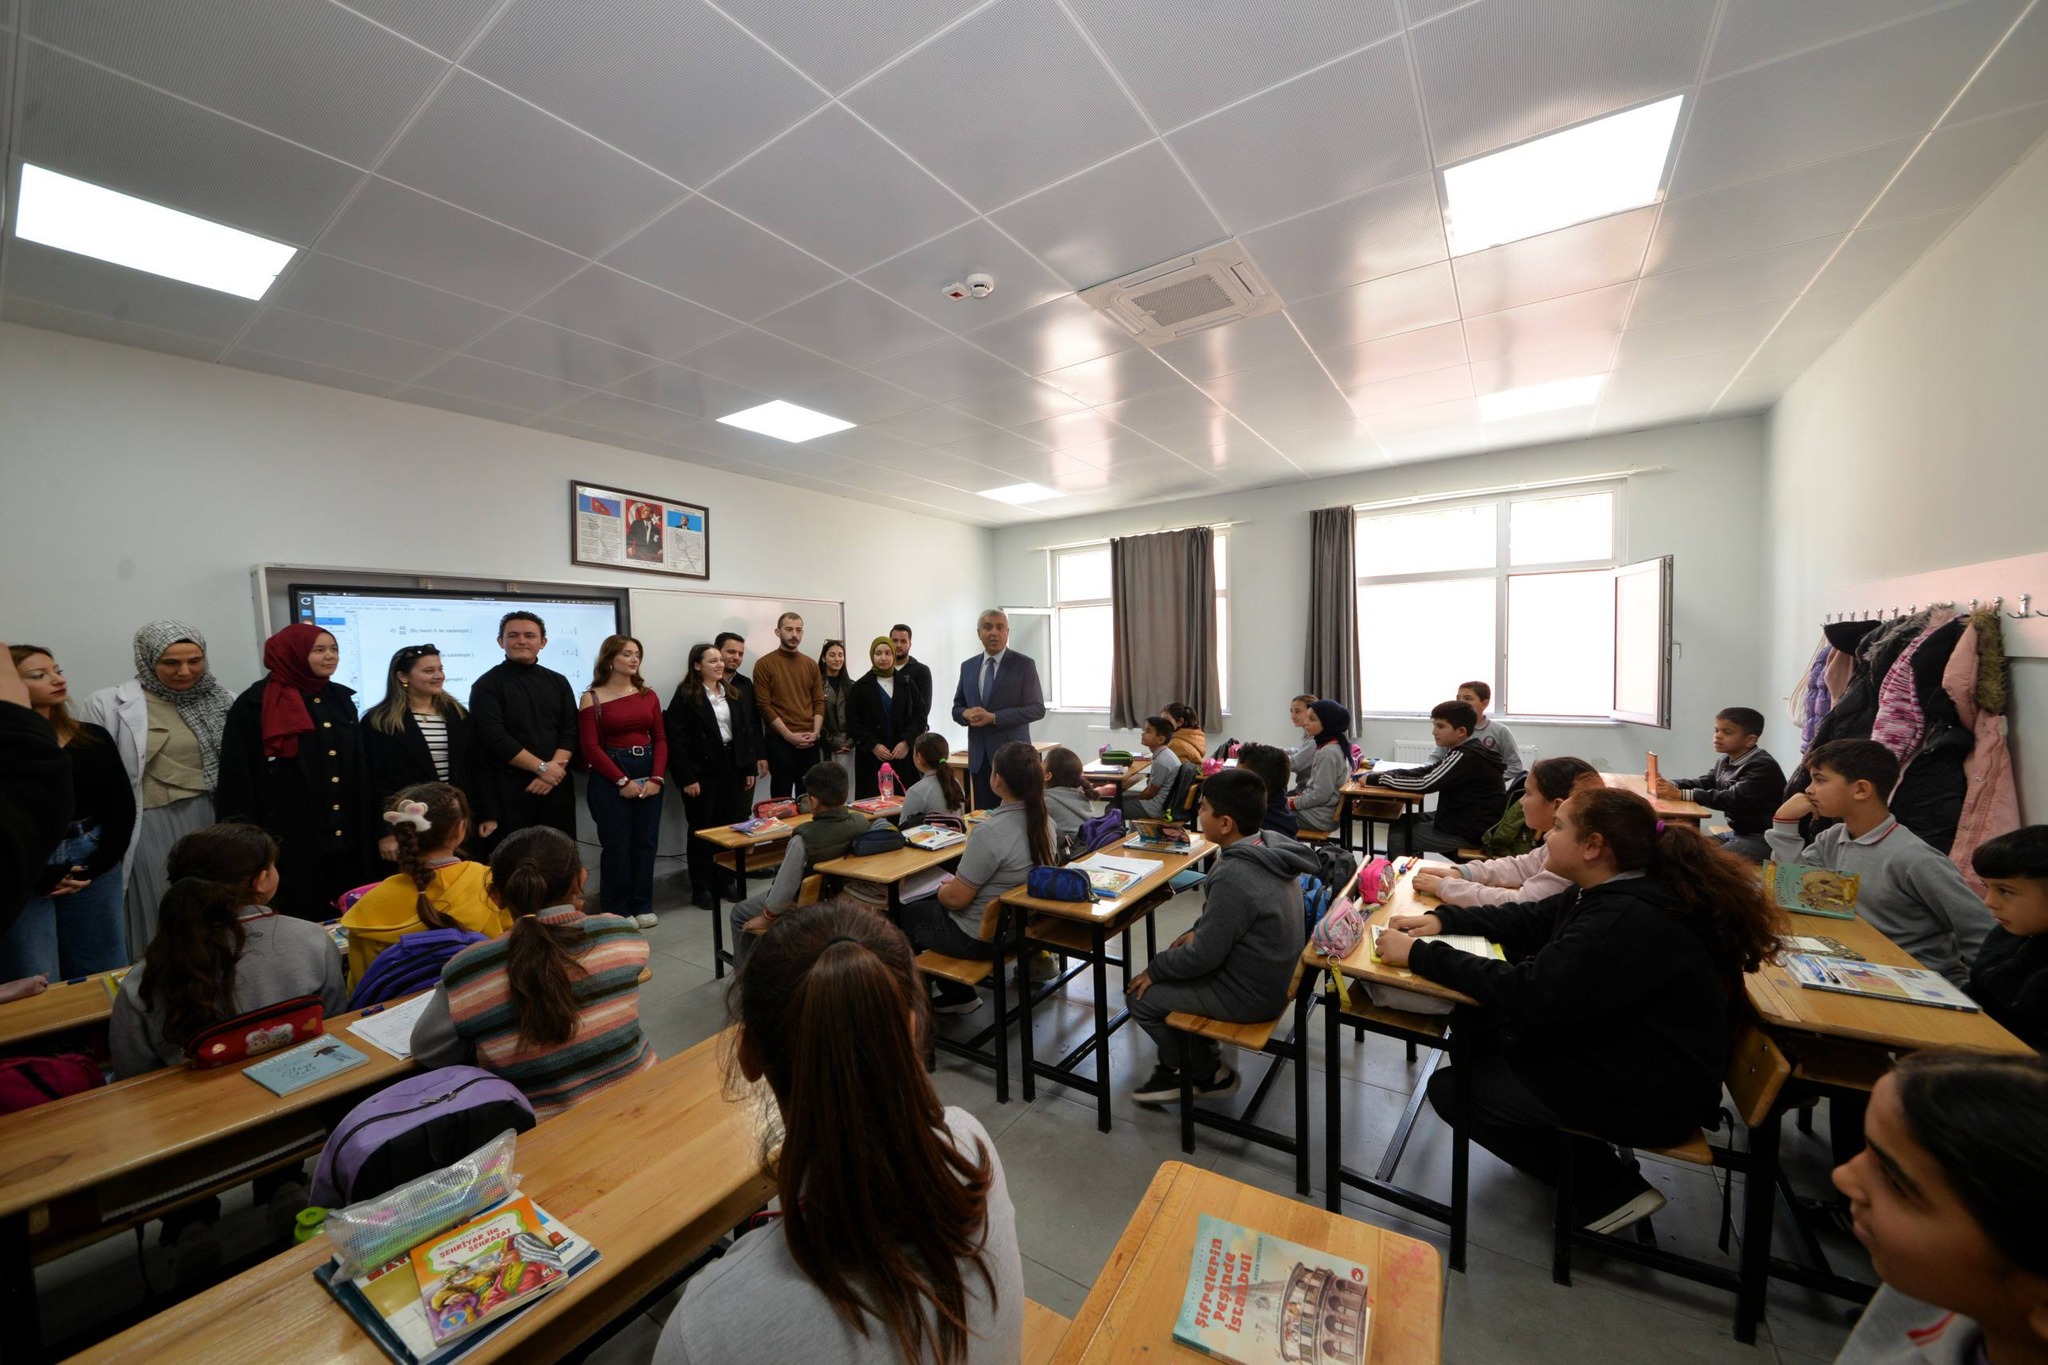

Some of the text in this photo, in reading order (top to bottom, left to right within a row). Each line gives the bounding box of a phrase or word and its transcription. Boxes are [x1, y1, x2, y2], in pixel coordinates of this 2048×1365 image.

[439, 1227, 499, 1259] ŞEHRİYAR ile
[468, 1227, 512, 1253] ŞEHRAZAT
[1194, 1238, 1223, 1329] Şifrelerin
[1212, 1252, 1236, 1323] Peşinde
